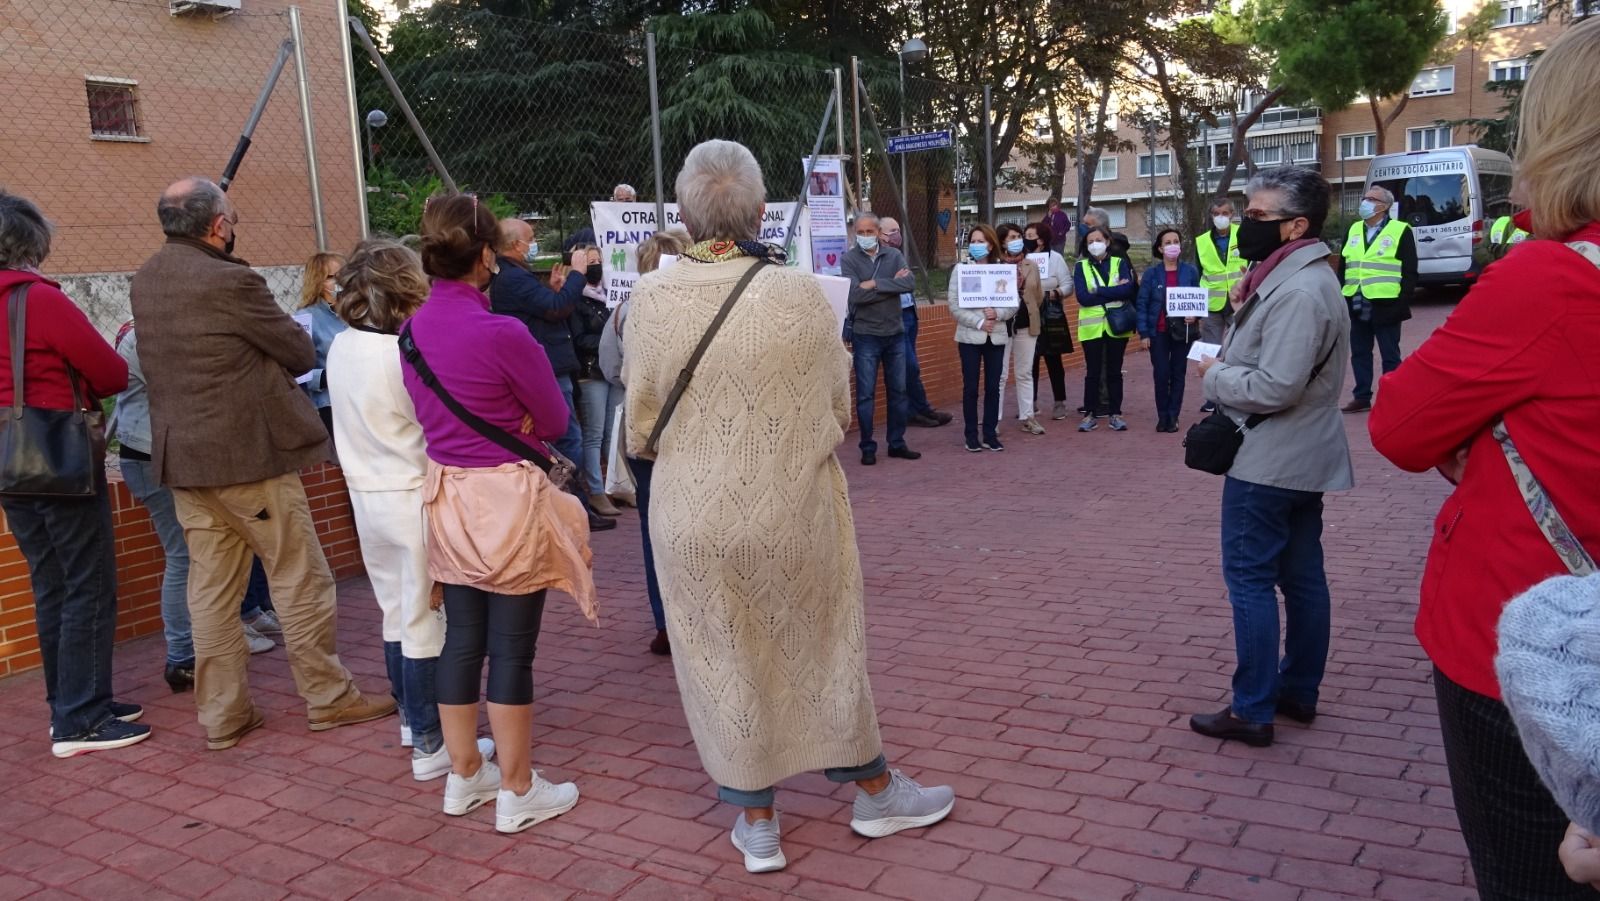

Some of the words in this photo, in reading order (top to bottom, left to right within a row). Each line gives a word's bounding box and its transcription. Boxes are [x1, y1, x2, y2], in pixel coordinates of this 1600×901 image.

[1374, 167, 1400, 177] CENTRO
[1403, 161, 1464, 174] SOCIOSANITARIO
[622, 211, 659, 224] OTRA
[762, 210, 784, 222] ONAL
[612, 279, 619, 288] EL
[610, 290, 618, 301] ES
[1169, 302, 1176, 311] ES
[1177, 302, 1206, 311] ASESINATO
